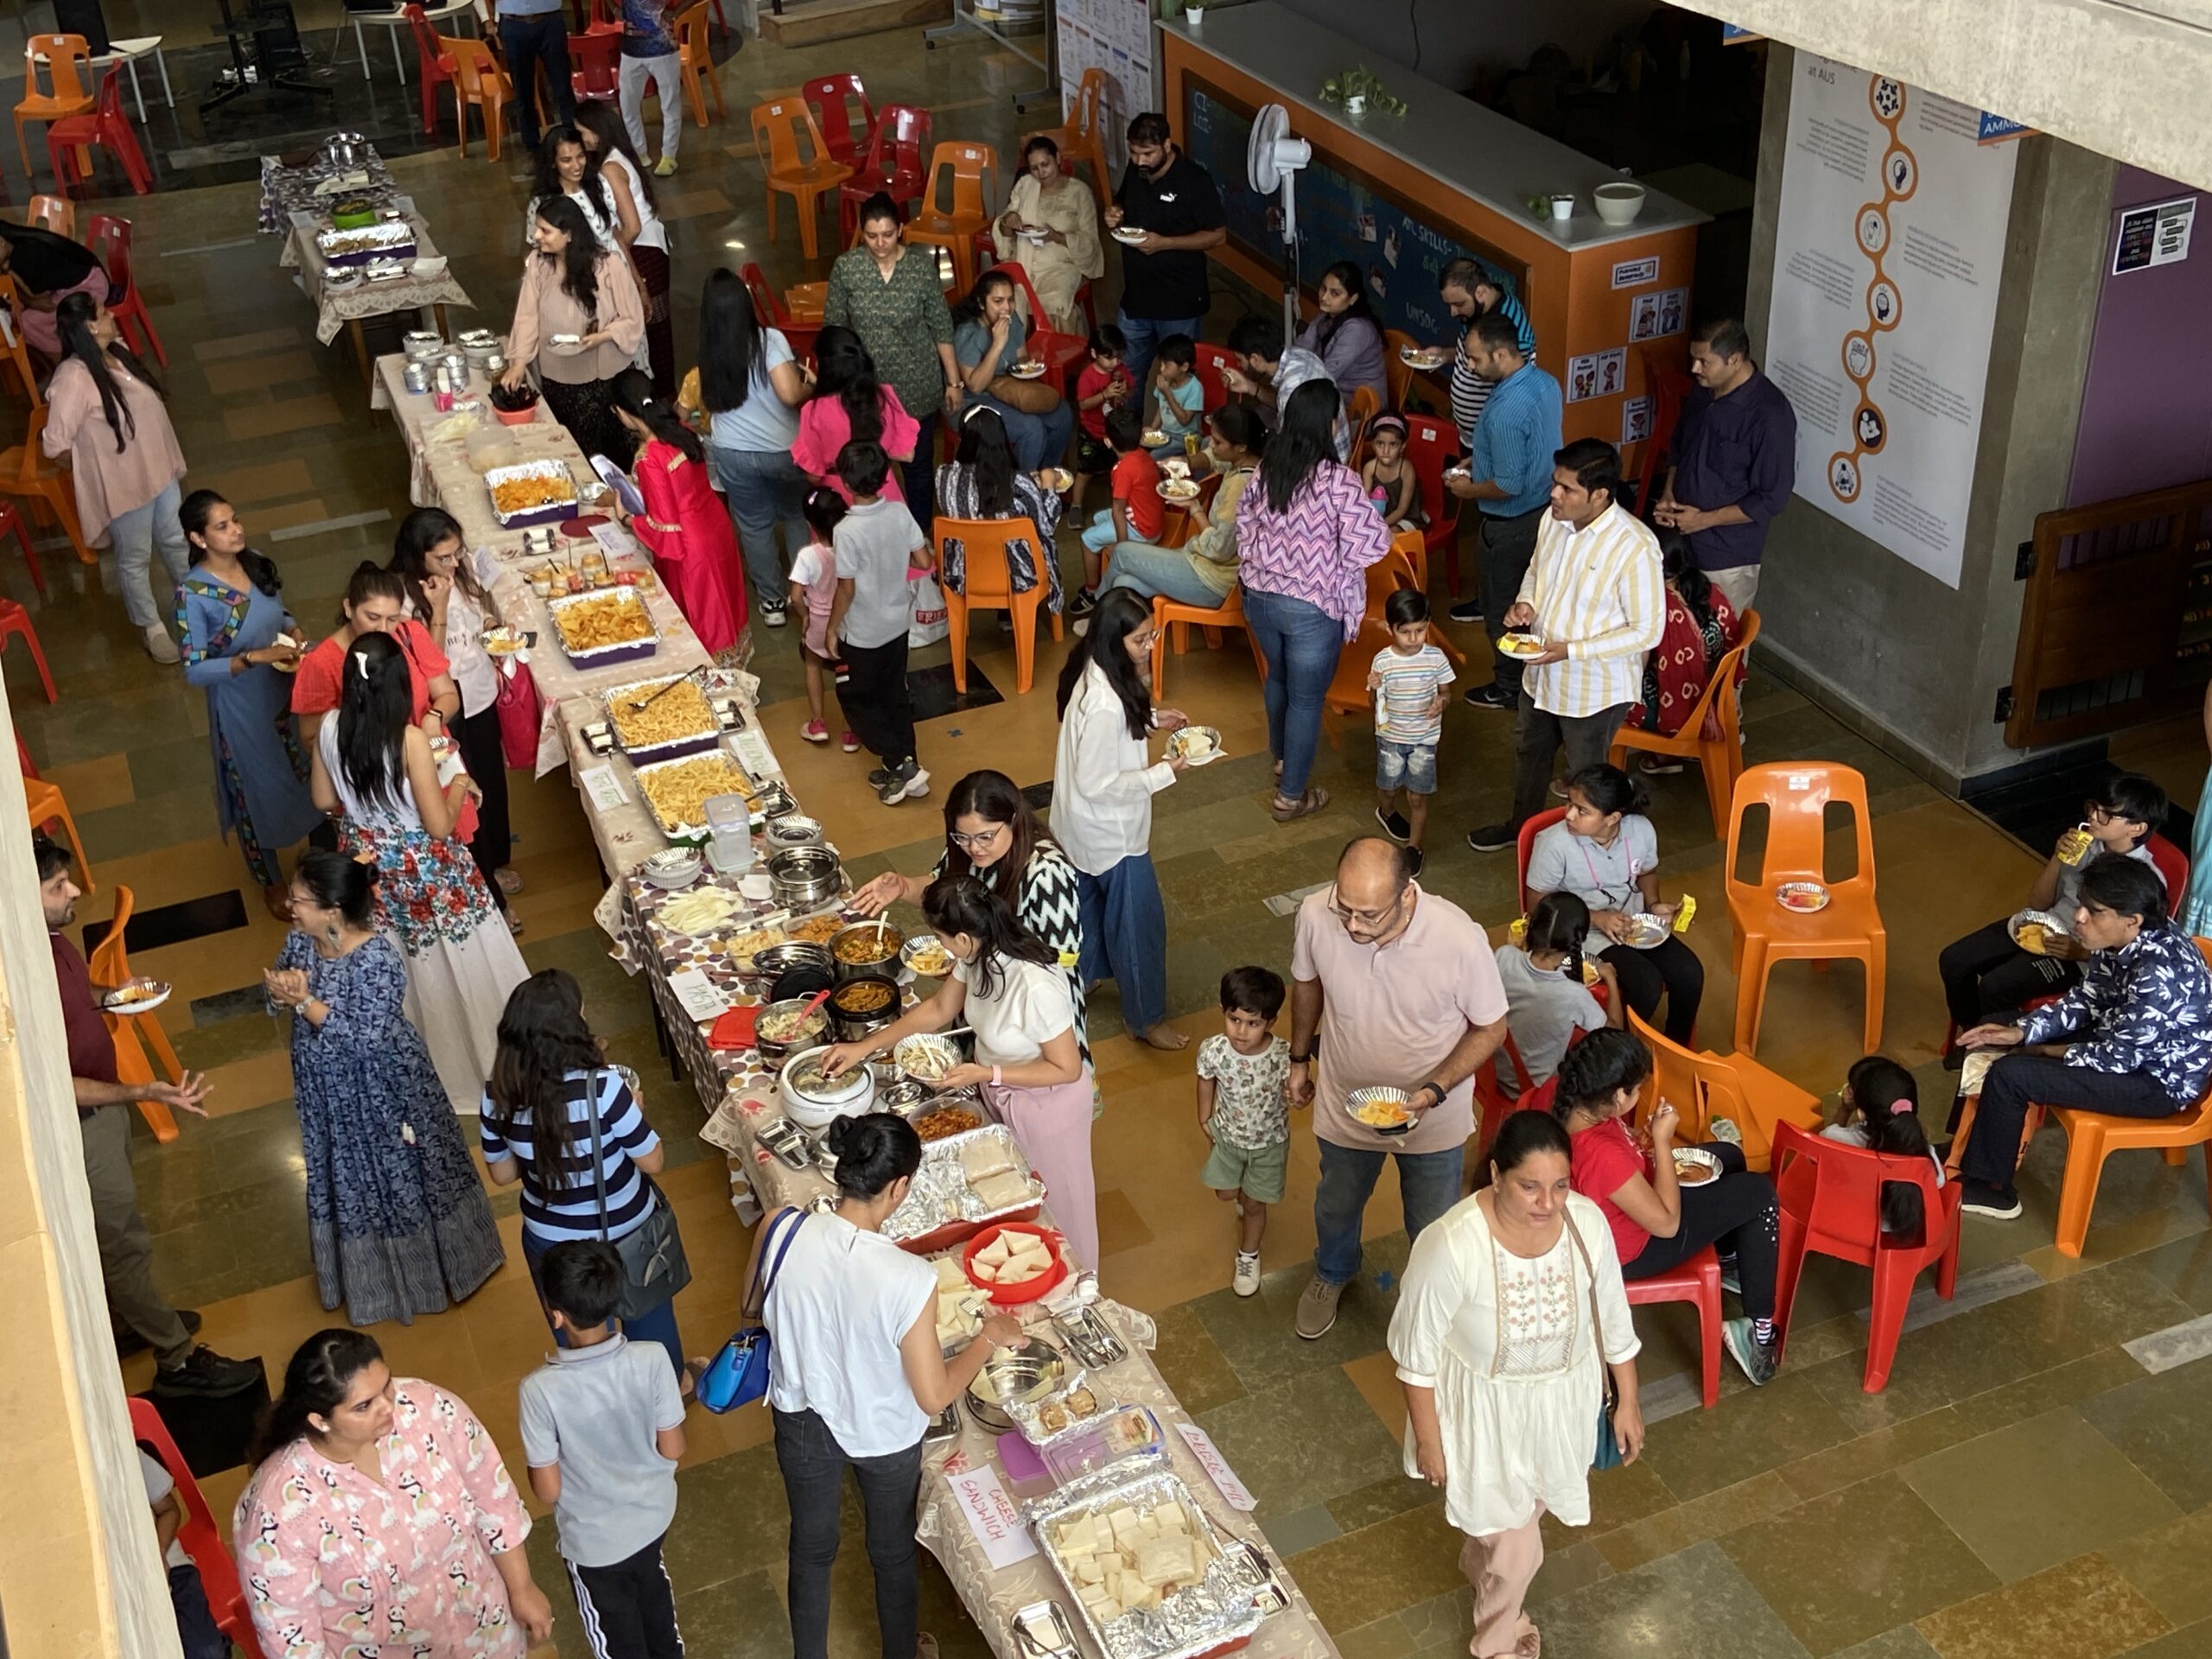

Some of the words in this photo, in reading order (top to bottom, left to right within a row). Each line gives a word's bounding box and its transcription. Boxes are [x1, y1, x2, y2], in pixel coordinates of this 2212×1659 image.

[1818, 69, 1835, 85] AUS
[685, 983, 716, 1014] PASTA
[960, 1479, 1007, 1541] SANDWICH
[988, 1489, 1018, 1529] CHEESE
